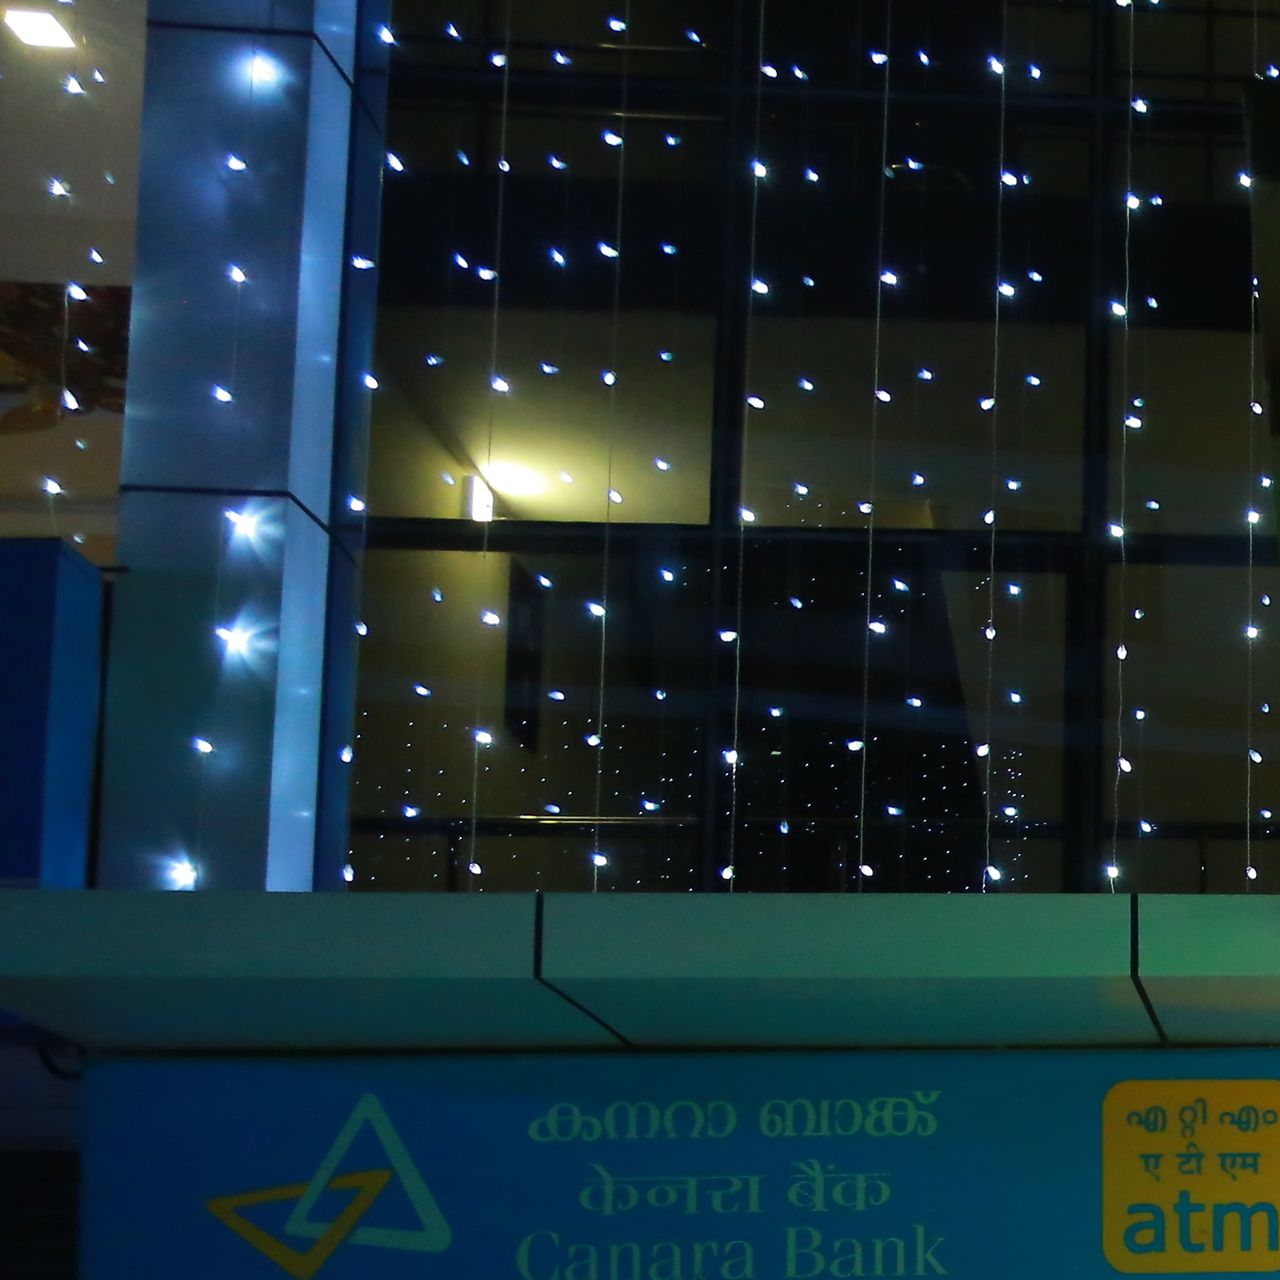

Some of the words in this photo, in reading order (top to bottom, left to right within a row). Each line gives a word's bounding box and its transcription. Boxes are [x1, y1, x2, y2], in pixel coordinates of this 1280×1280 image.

[528, 1099, 738, 1142] കനറാ
[758, 1090, 942, 1138] ബാങ്ക്
[578, 1162, 766, 1216] केनरा
[786, 1158, 892, 1213] बैंक
[1138, 1152, 1164, 1182] ए
[1175, 1142, 1204, 1175] टी
[1217, 1152, 1262, 1181] एम
[1123, 1190, 1280, 1254] atm
[783, 1224, 949, 1280] Bank
